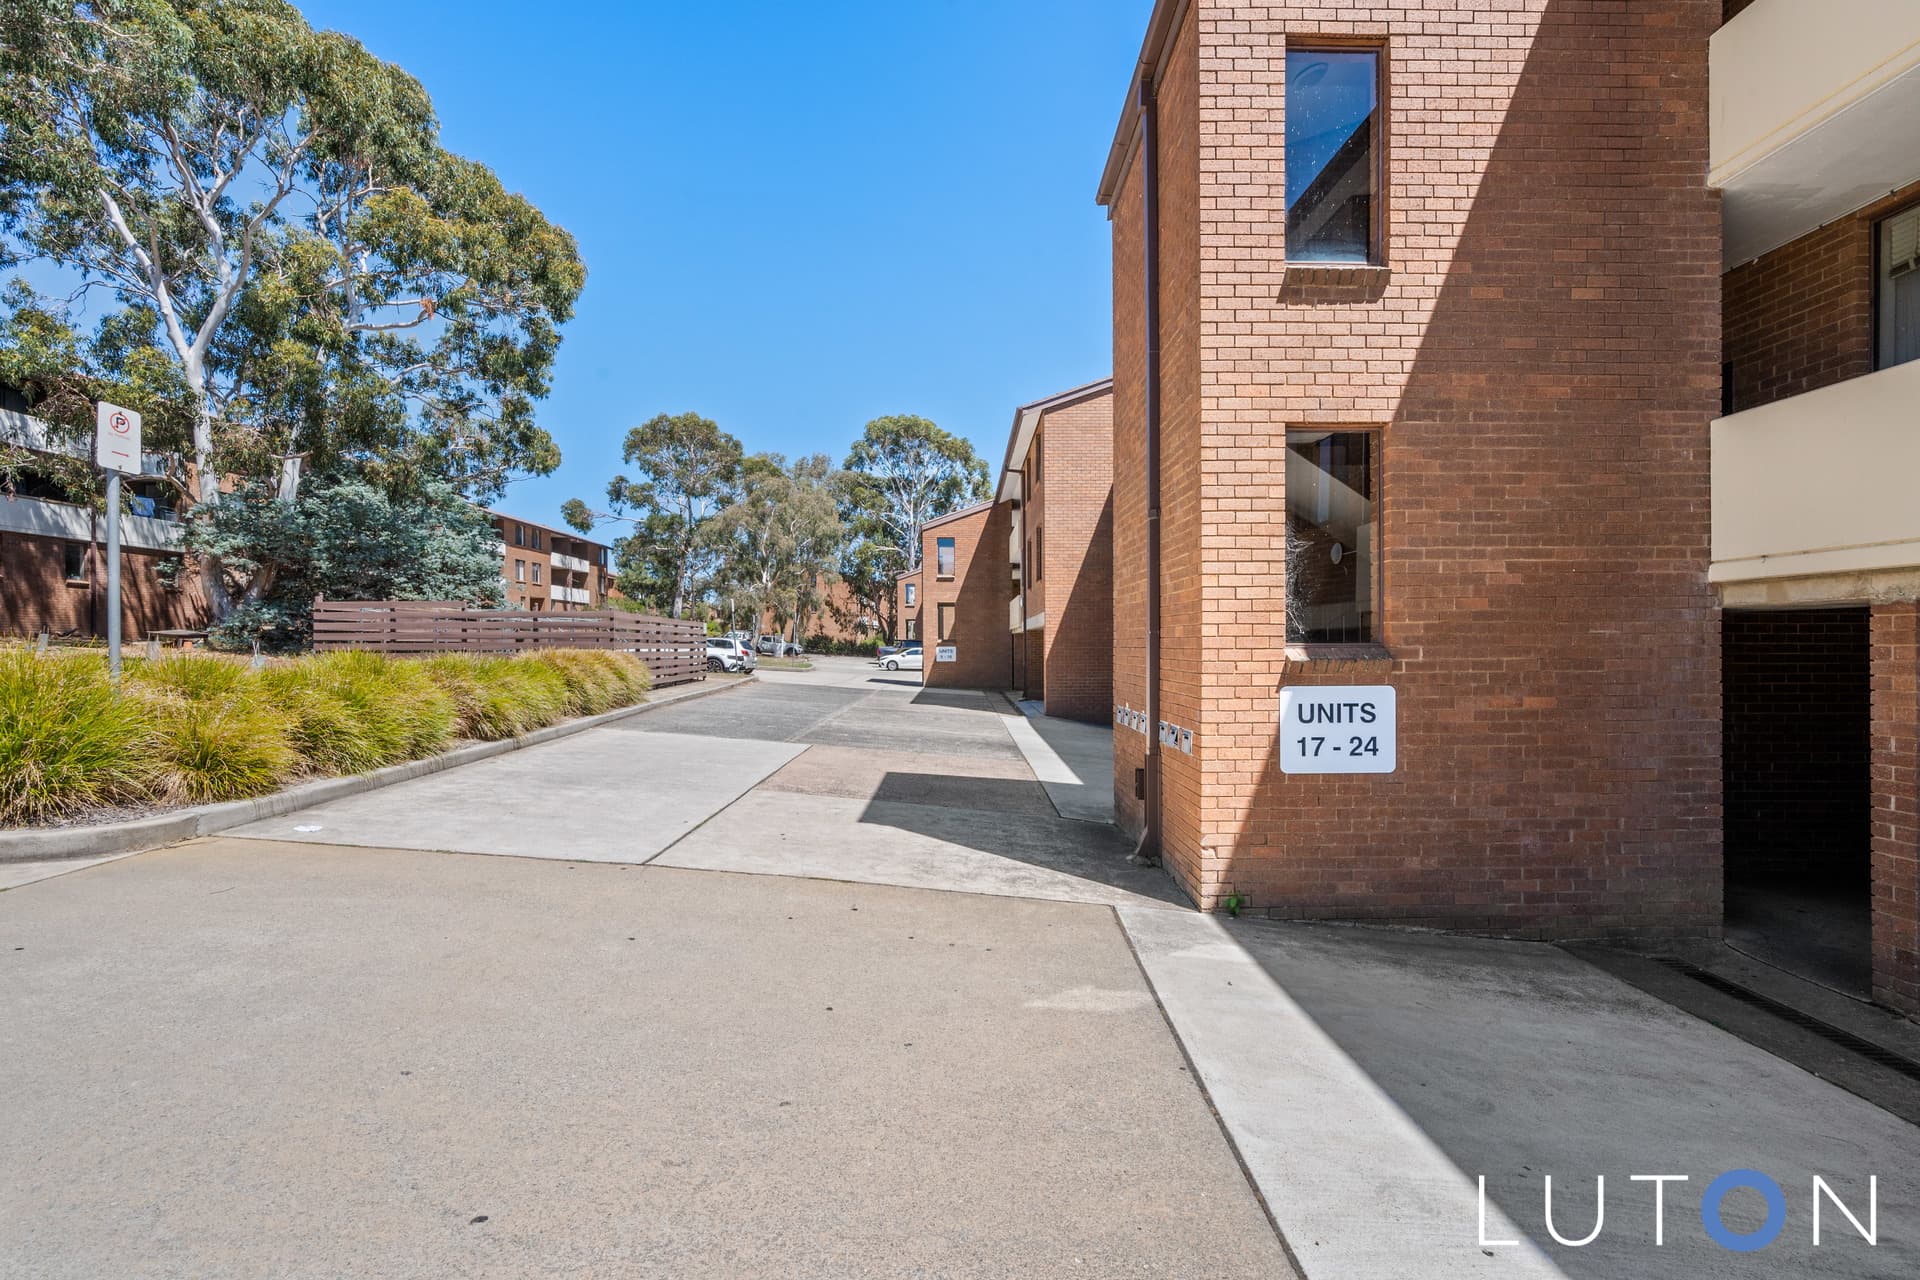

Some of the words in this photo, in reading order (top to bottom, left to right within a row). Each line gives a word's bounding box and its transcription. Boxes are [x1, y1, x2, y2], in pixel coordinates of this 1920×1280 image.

[1298, 702, 1377, 724] UNITS
[1297, 736, 1326, 757] 17
[1349, 736, 1379, 757] 24
